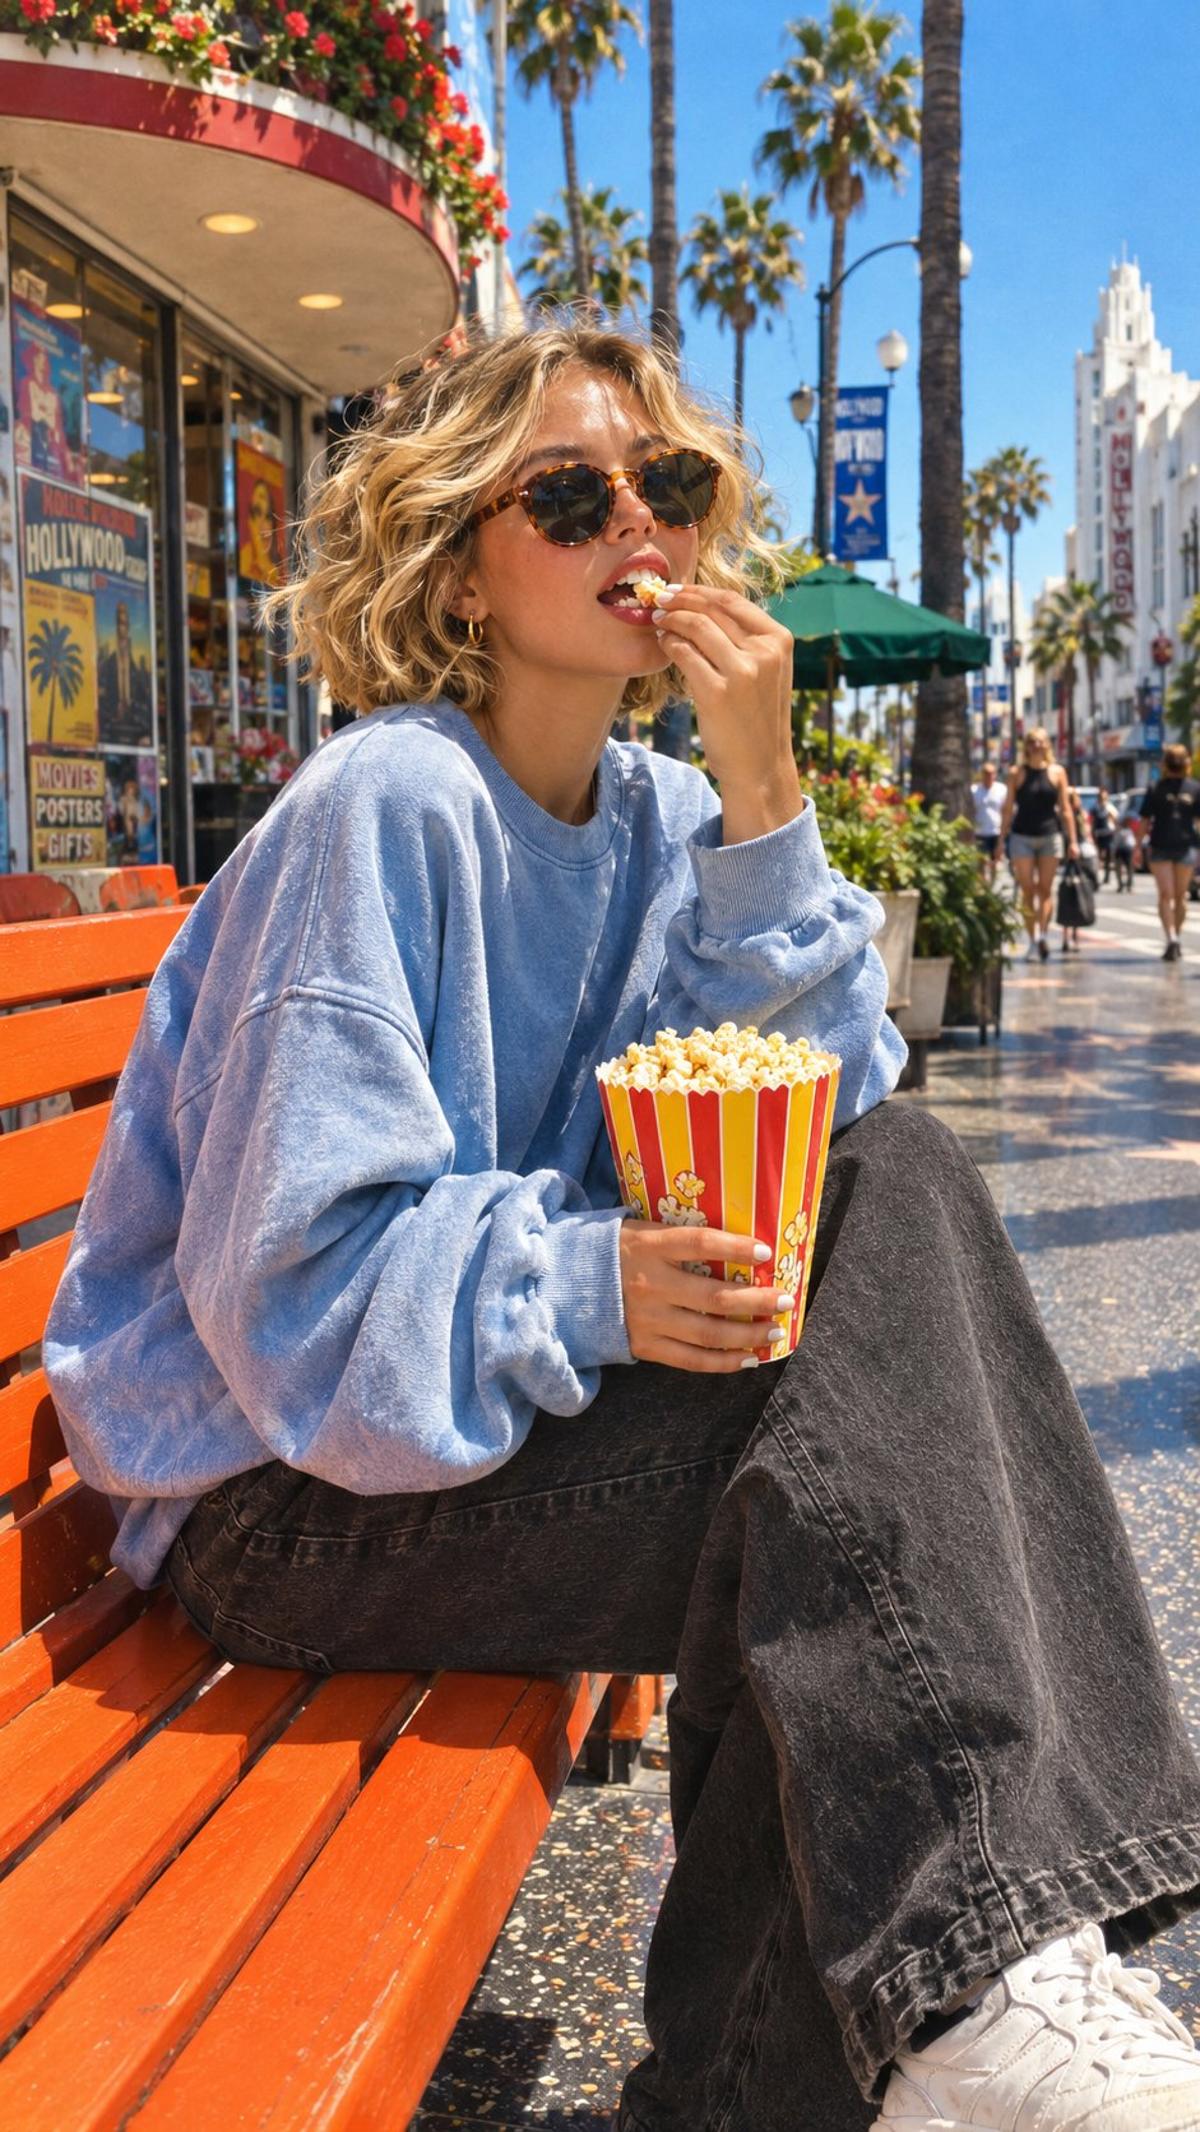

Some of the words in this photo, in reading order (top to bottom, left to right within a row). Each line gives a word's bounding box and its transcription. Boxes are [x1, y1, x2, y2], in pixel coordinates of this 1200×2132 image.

[26, 522, 125, 574] HOLLYWOOD
[36, 762, 98, 790] MOVIES
[36, 797, 103, 824] POSTERS
[48, 832, 93, 860] GIFTS
